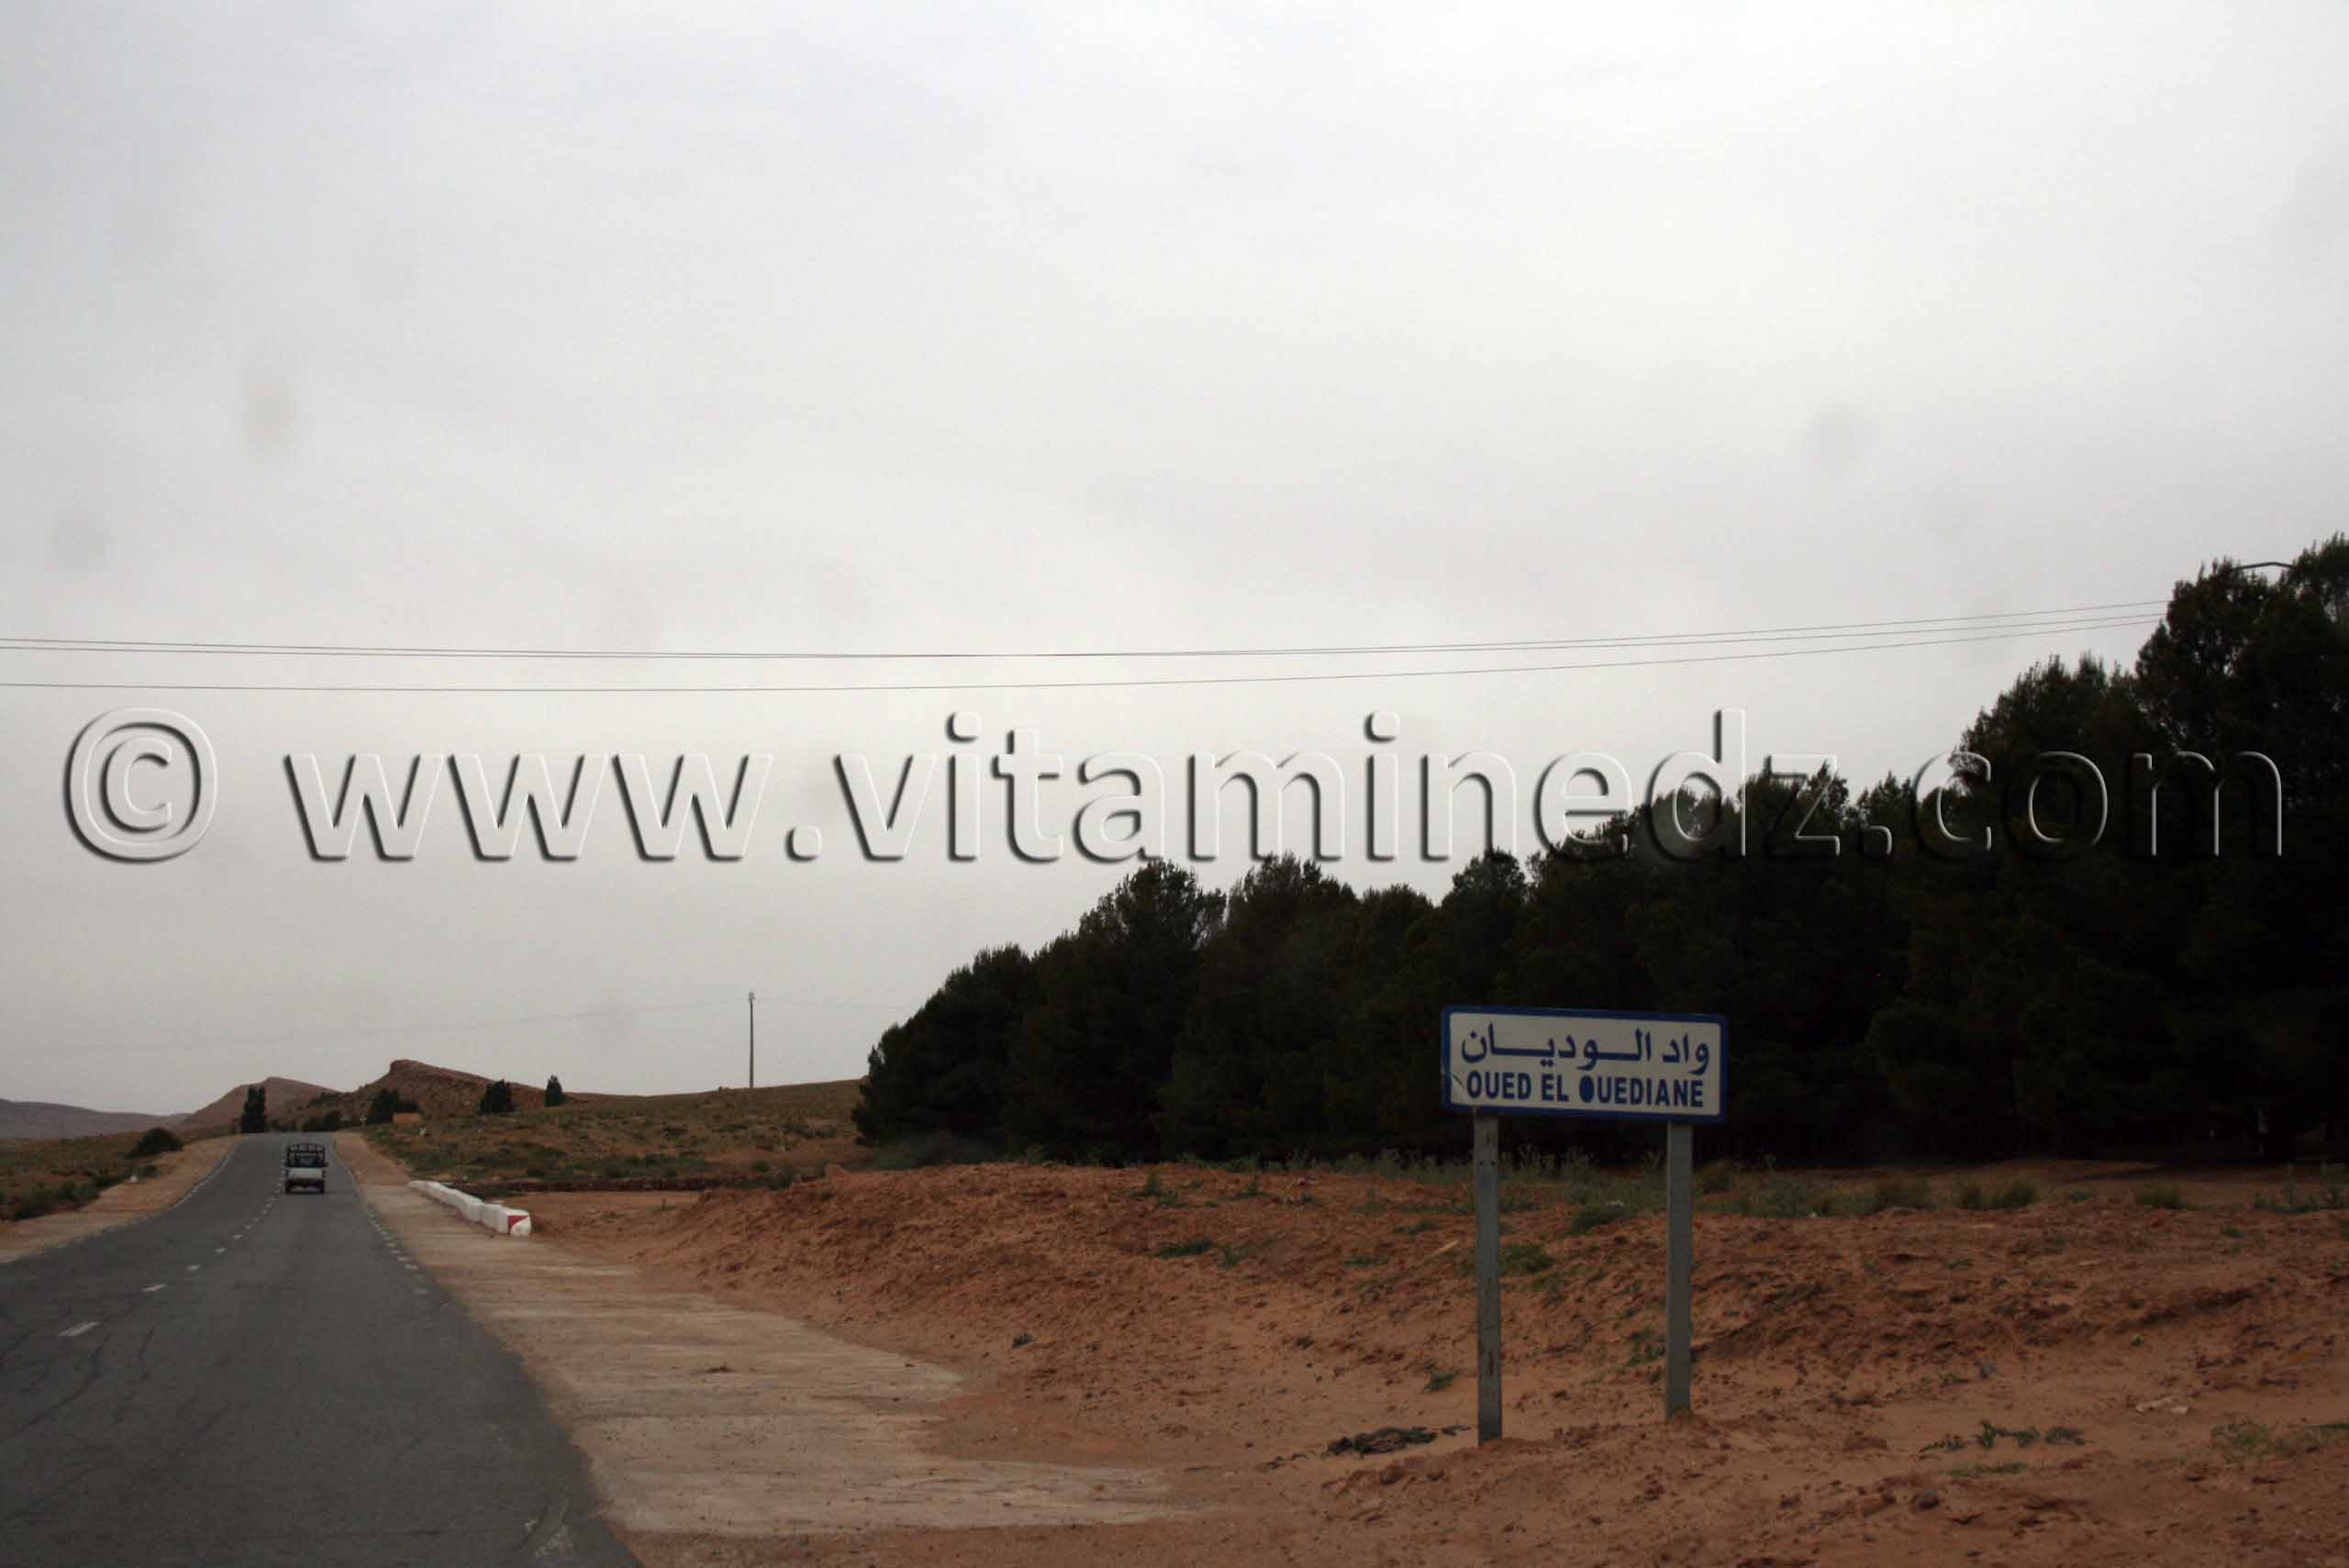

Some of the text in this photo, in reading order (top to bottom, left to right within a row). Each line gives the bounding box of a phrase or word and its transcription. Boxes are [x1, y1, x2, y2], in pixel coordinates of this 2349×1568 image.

[1662, 1032, 1709, 1076] واد
[1467, 1070, 1704, 1107] OUED EL OUEDIANE
